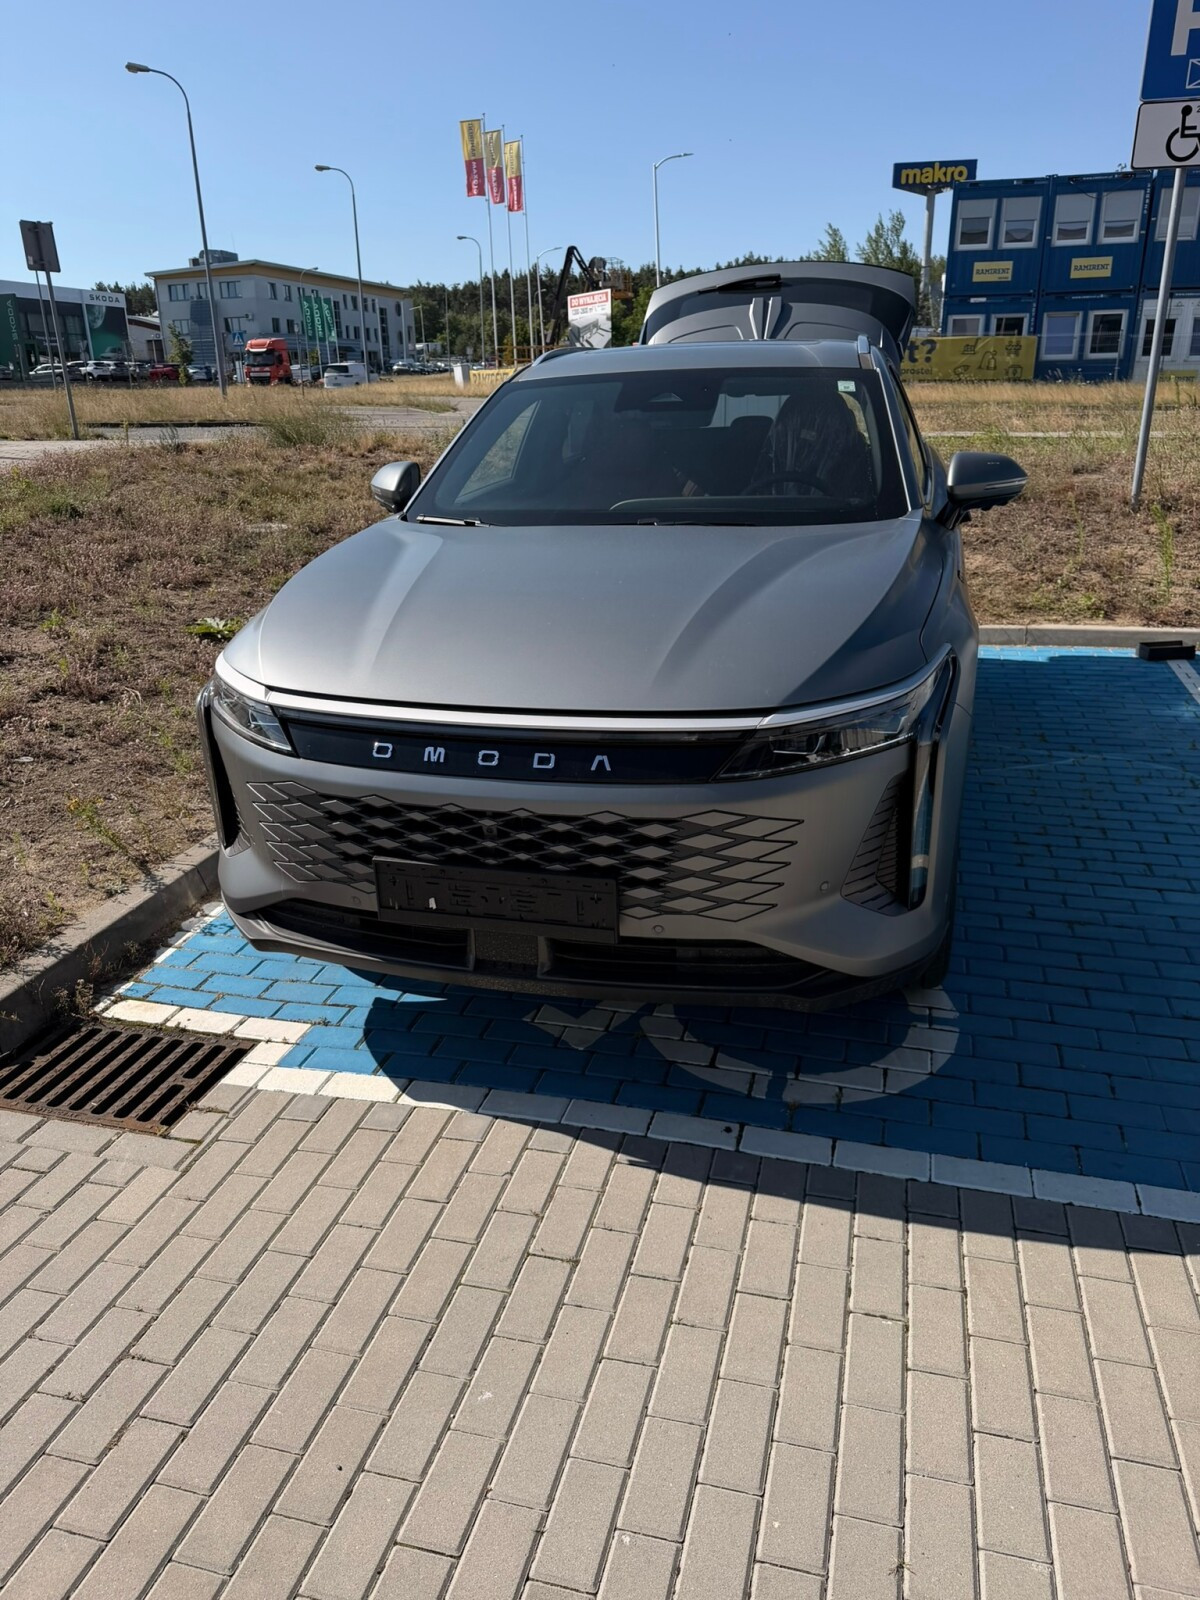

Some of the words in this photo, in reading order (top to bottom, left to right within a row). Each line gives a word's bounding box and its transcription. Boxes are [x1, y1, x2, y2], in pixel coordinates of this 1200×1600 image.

[901, 162, 968, 184] makro
[1073, 264, 1110, 272] RAMIRENT
[901, 339, 936, 363] t?
